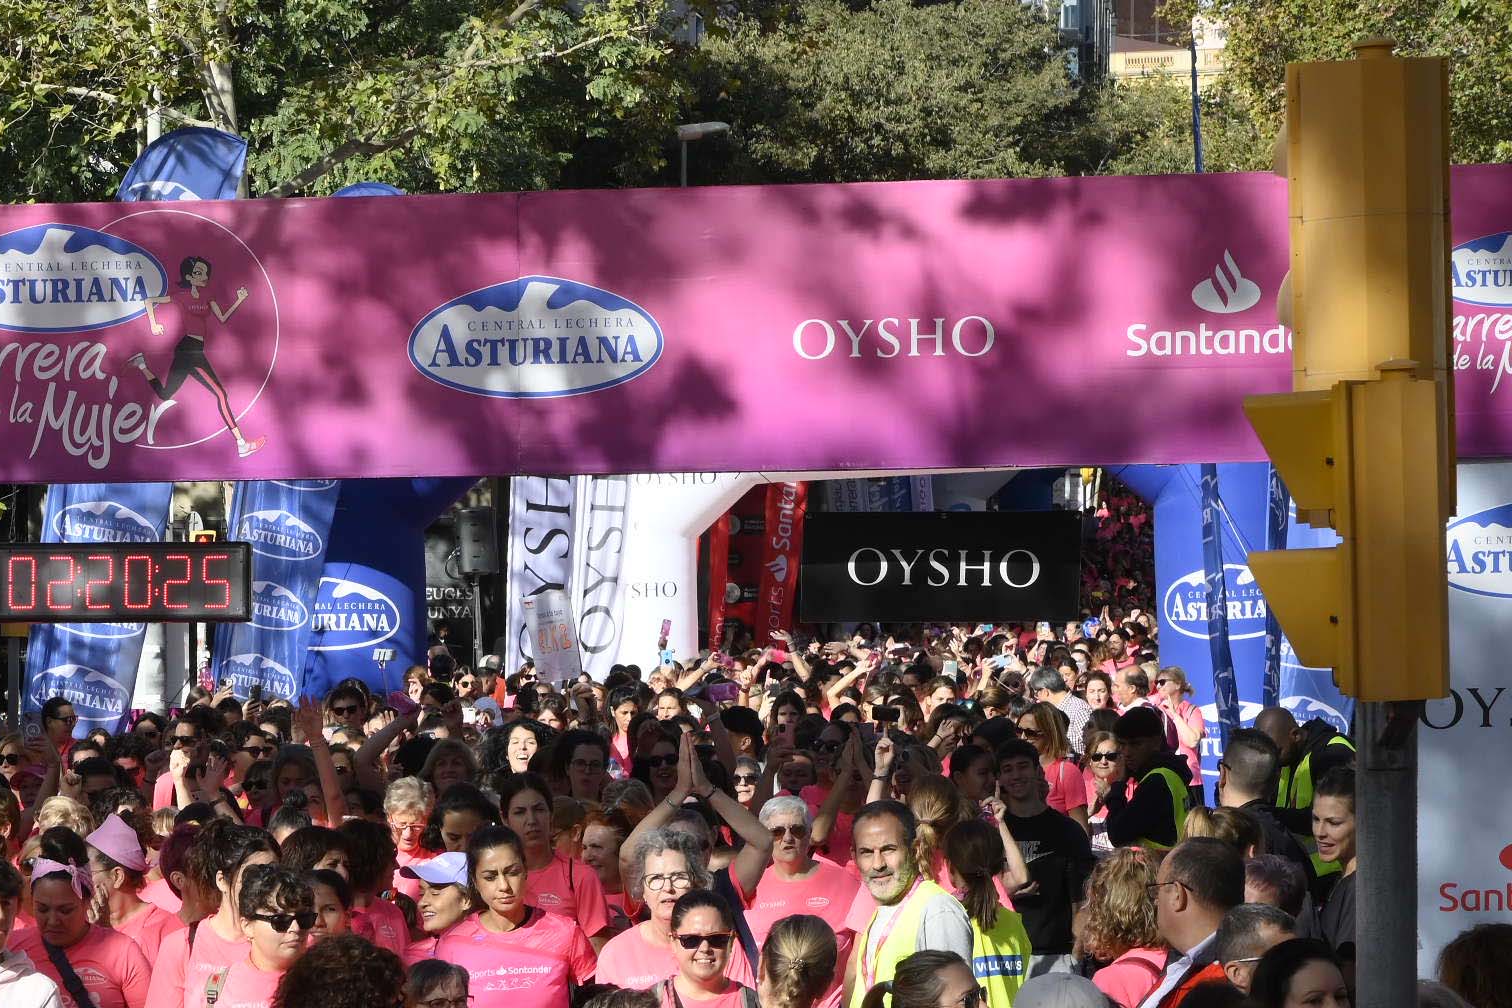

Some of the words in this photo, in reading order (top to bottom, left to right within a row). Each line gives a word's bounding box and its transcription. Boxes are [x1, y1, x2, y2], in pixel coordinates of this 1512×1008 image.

[71, 259, 144, 272] LECHERA
[1467, 257, 1512, 267] CENTRA
[467, 318, 546, 332] CENTRAL
[554, 316, 635, 330] LECHERA
[793, 315, 995, 360] OYSHO
[428, 322, 644, 370] ASTURIANA
[1126, 323, 1294, 357] Santand
[1476, 342, 1494, 371] la
[9, 383, 35, 424] la
[28, 376, 178, 470] Mujer
[238, 520, 315, 555] ASTURIANA
[1473, 534, 1512, 545] CENT
[847, 547, 1040, 588] OYSHO
[1447, 537, 1512, 575] ASTU
[8, 554, 231, 610] 02:20:25
[631, 581, 678, 598] SHO
[315, 602, 333, 610] RAL
[338, 602, 386, 611] LECHERA
[1170, 591, 1266, 622] ASTRIA
[311, 613, 391, 632] URIANA
[1419, 687, 1512, 730] OY
[507, 965, 553, 976] Santander
